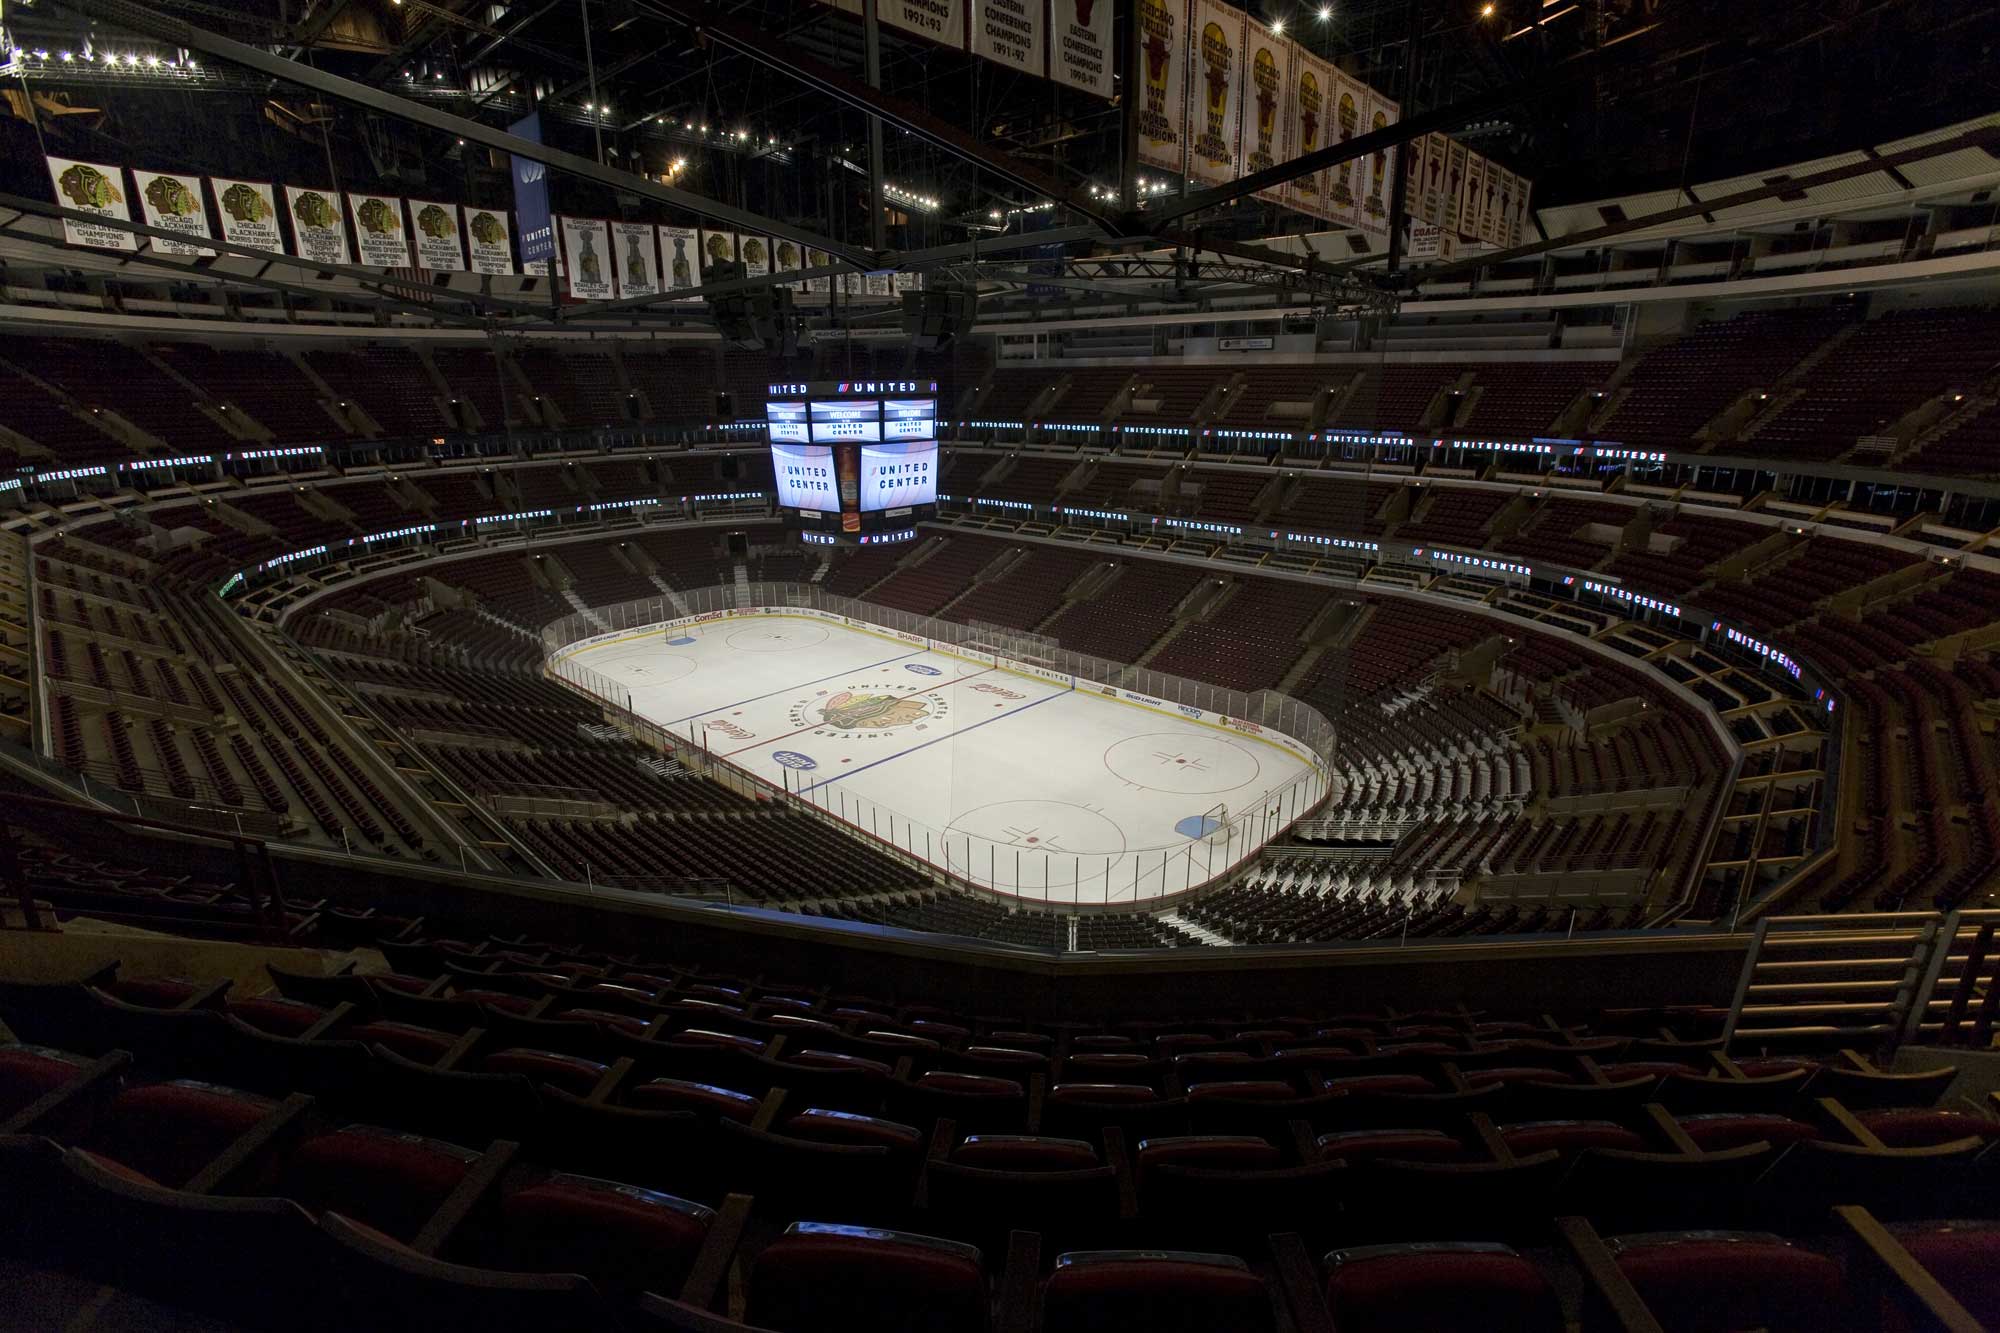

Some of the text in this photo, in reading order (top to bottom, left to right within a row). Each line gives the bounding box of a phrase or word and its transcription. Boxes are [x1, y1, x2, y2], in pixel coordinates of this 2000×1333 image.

[906, 0, 949, 18] AMPIONS
[1140, 1, 1174, 26] CHICAGO
[903, 7, 942, 32] 1992-93
[985, 6, 1032, 34] CONFERENCE
[985, 23, 1031, 49] CHAMPIONS
[1070, 24, 1097, 44] EASTERN
[993, 42, 1025, 62] 1991-92
[1063, 36, 1102, 60] CONFERENCE
[1204, 39, 1232, 59] CHICAGO
[1064, 55, 1102, 74] CHAMPIONS
[1137, 123, 1177, 144] HAMPIONS
[154, 220, 203, 231] BLACKHAWKS
[161, 215, 193, 224] CHICAGO
[231, 227, 275, 237] BLACKHAWKS
[237, 222, 266, 230] CHICAGO
[306, 227, 333, 235] CHICAGO
[77, 229, 124, 240] CHAMPIONS
[227, 235, 280, 245] NORRIS DIVISION
[300, 232, 341, 241] BLACKHAWKS
[527, 227, 550, 242] UNITED
[85, 238, 120, 248] 1992-93
[364, 239, 402, 247] BLACKHAWKS
[528, 242, 552, 255] CENTER
[306, 250, 341, 258] CHAMPIONS
[369, 252, 401, 260] CHAMPIONS
[854, 383, 916, 393] UNITED
[830, 411, 862, 419] WELCOME
[787, 466, 827, 477] UNITED
[880, 462, 928, 475] UNITED
[789, 479, 829, 491] CENTER
[880, 476, 927, 489] CENTER
[873, 530, 914, 543] UNITED
[695, 611, 723, 622] ComEd
[898, 632, 923, 643] SHARP
[1042, 670, 1069, 682] UNITED
[1126, 693, 1162, 706] BUD LIGHT
[928, 693, 948, 720] CENTER
[814, 729, 893, 739] UNITED
